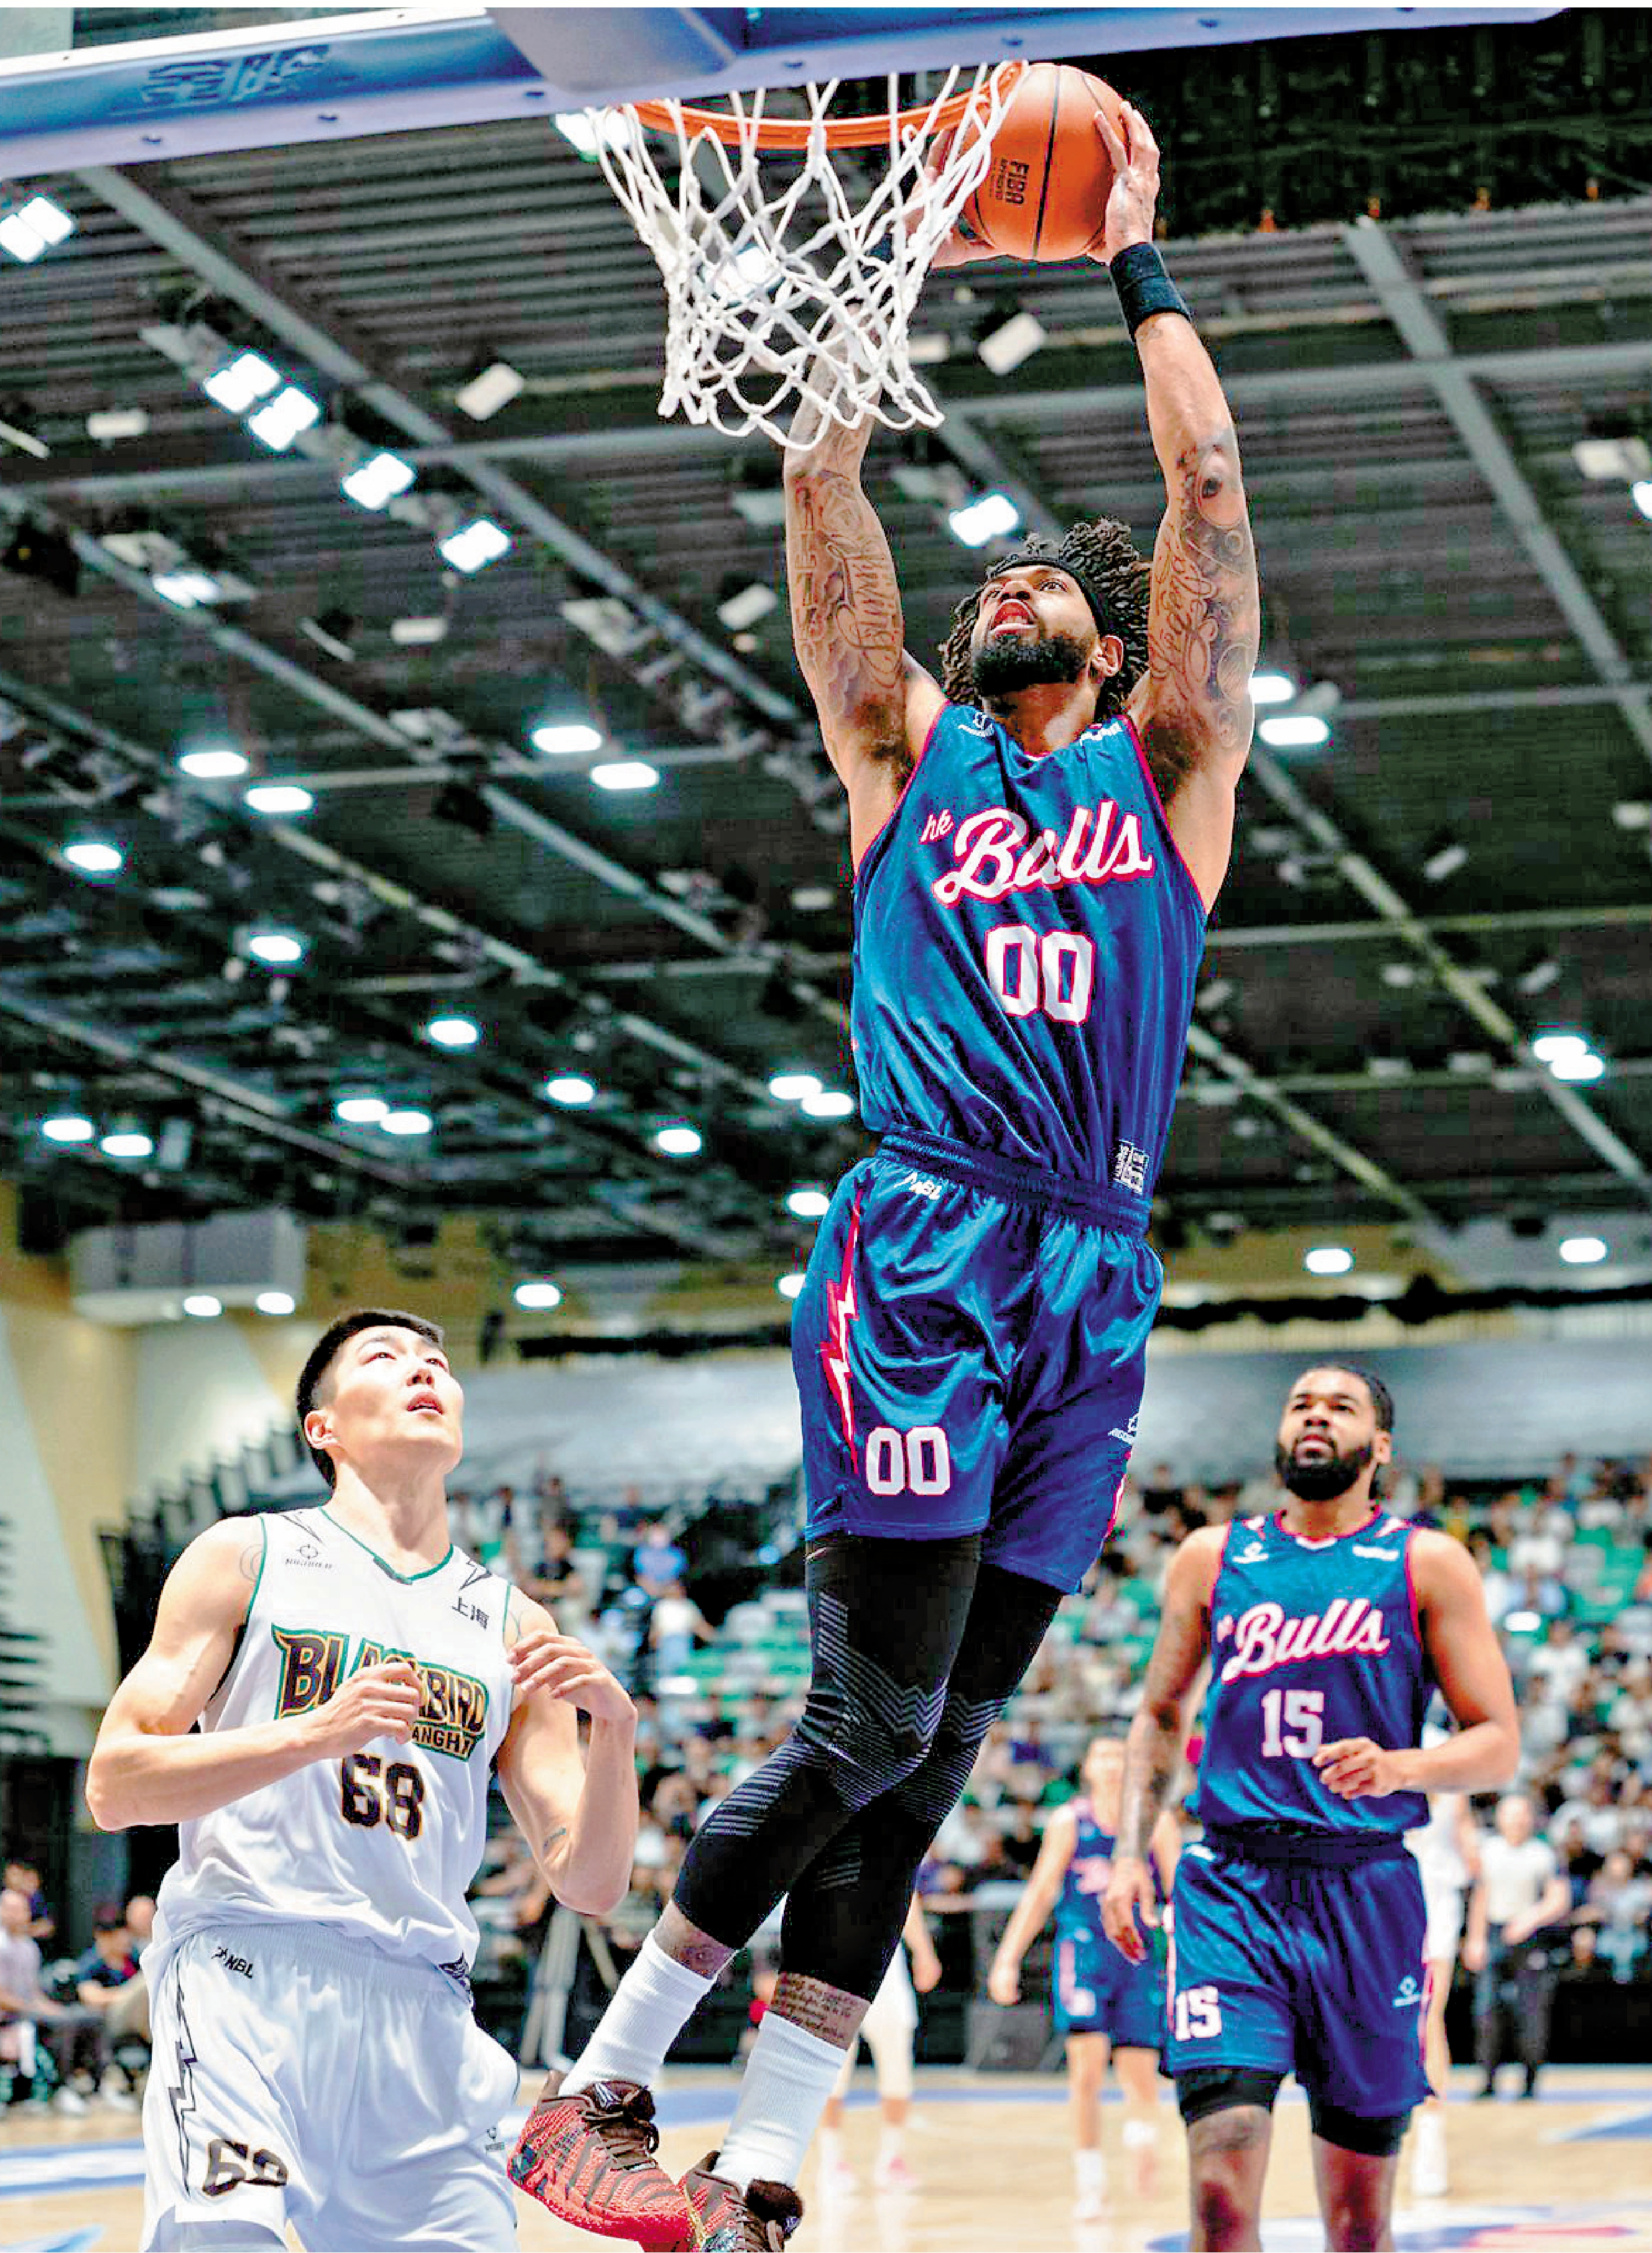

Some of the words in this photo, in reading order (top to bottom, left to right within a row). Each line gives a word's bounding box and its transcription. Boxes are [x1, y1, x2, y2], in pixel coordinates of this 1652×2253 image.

[1006, 160, 1029, 204] FIBA
[920, 809, 954, 844] hk
[932, 799, 1155, 909] Bulls
[985, 924, 1095, 1025] 00
[866, 1426, 950, 1496] 00
[1221, 1598, 1390, 1684] Bulls
[271, 1623, 489, 1734] BLBIRD
[1261, 1688, 1325, 1759] 15
[340, 1752, 425, 1841] 68
[225, 1955, 253, 1979] NBL
[1175, 1986, 1223, 2042] 15
